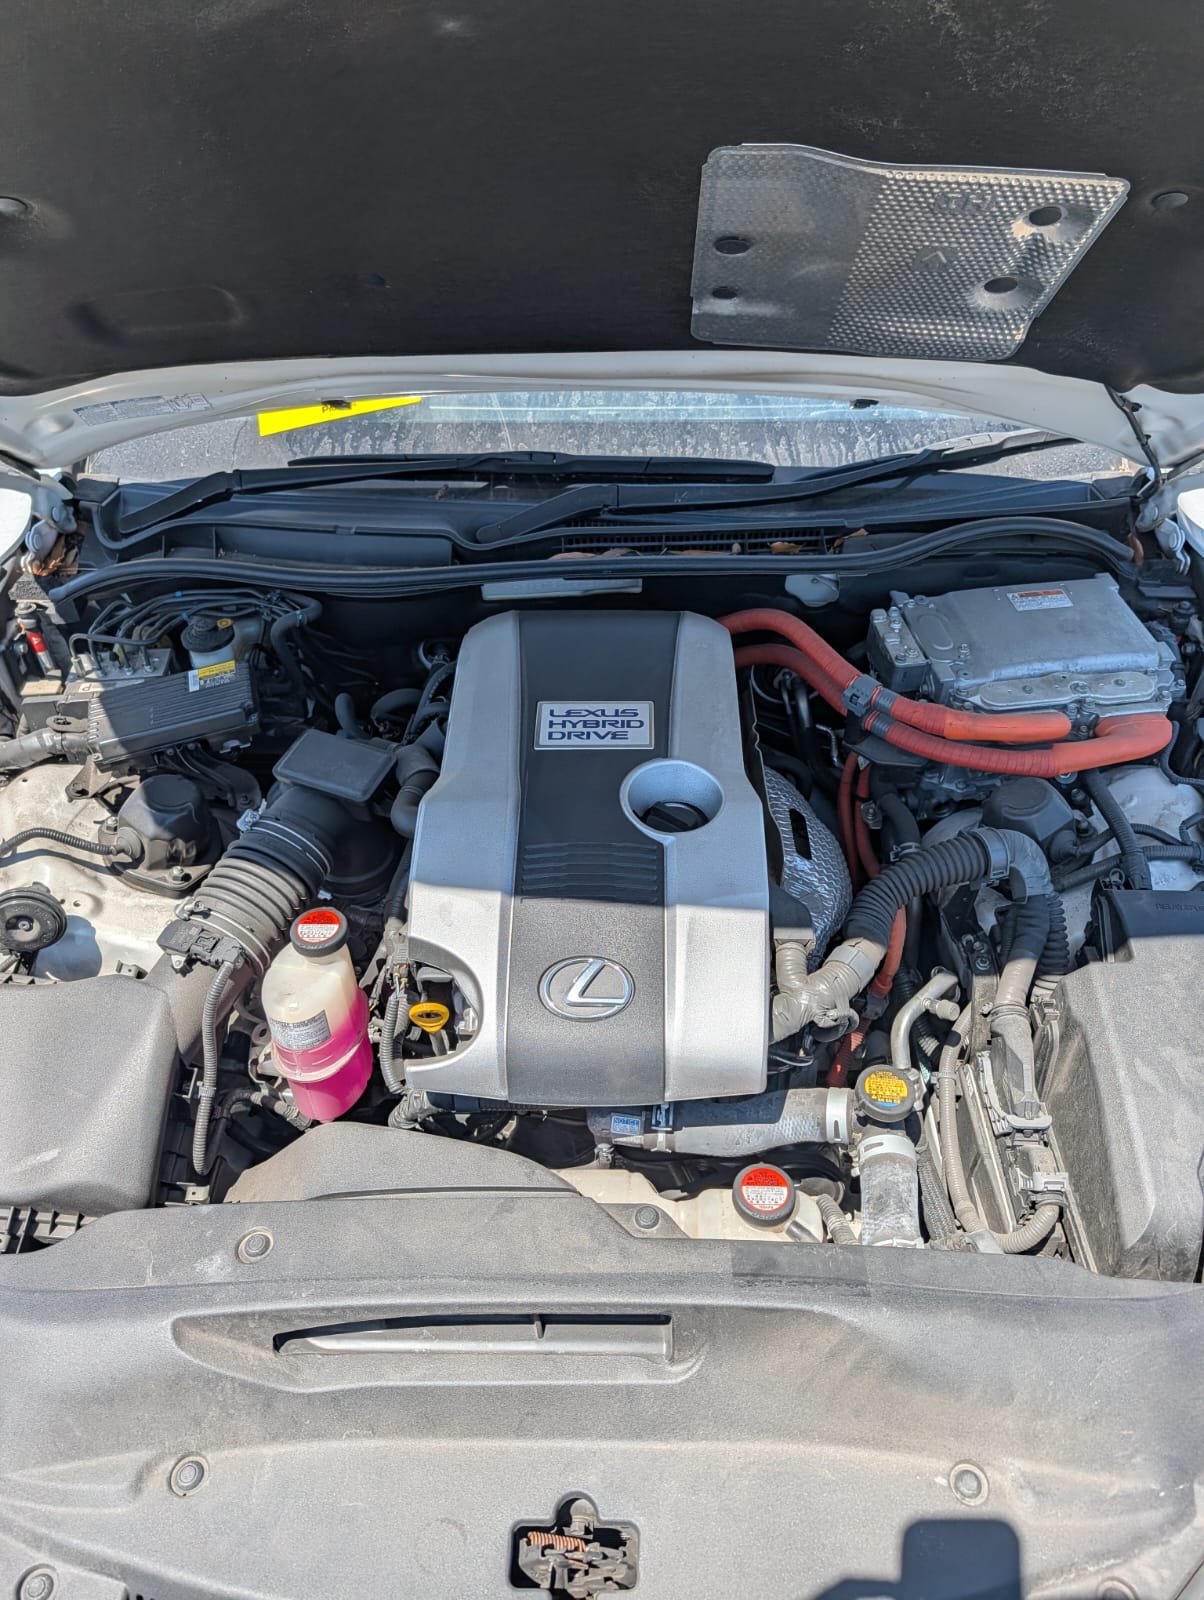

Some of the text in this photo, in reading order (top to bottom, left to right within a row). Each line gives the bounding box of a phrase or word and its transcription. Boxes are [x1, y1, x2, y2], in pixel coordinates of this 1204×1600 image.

[549, 708, 640, 718] LEXUS
[548, 719, 645, 729] HYBRID
[547, 730, 629, 740] DRIVE
